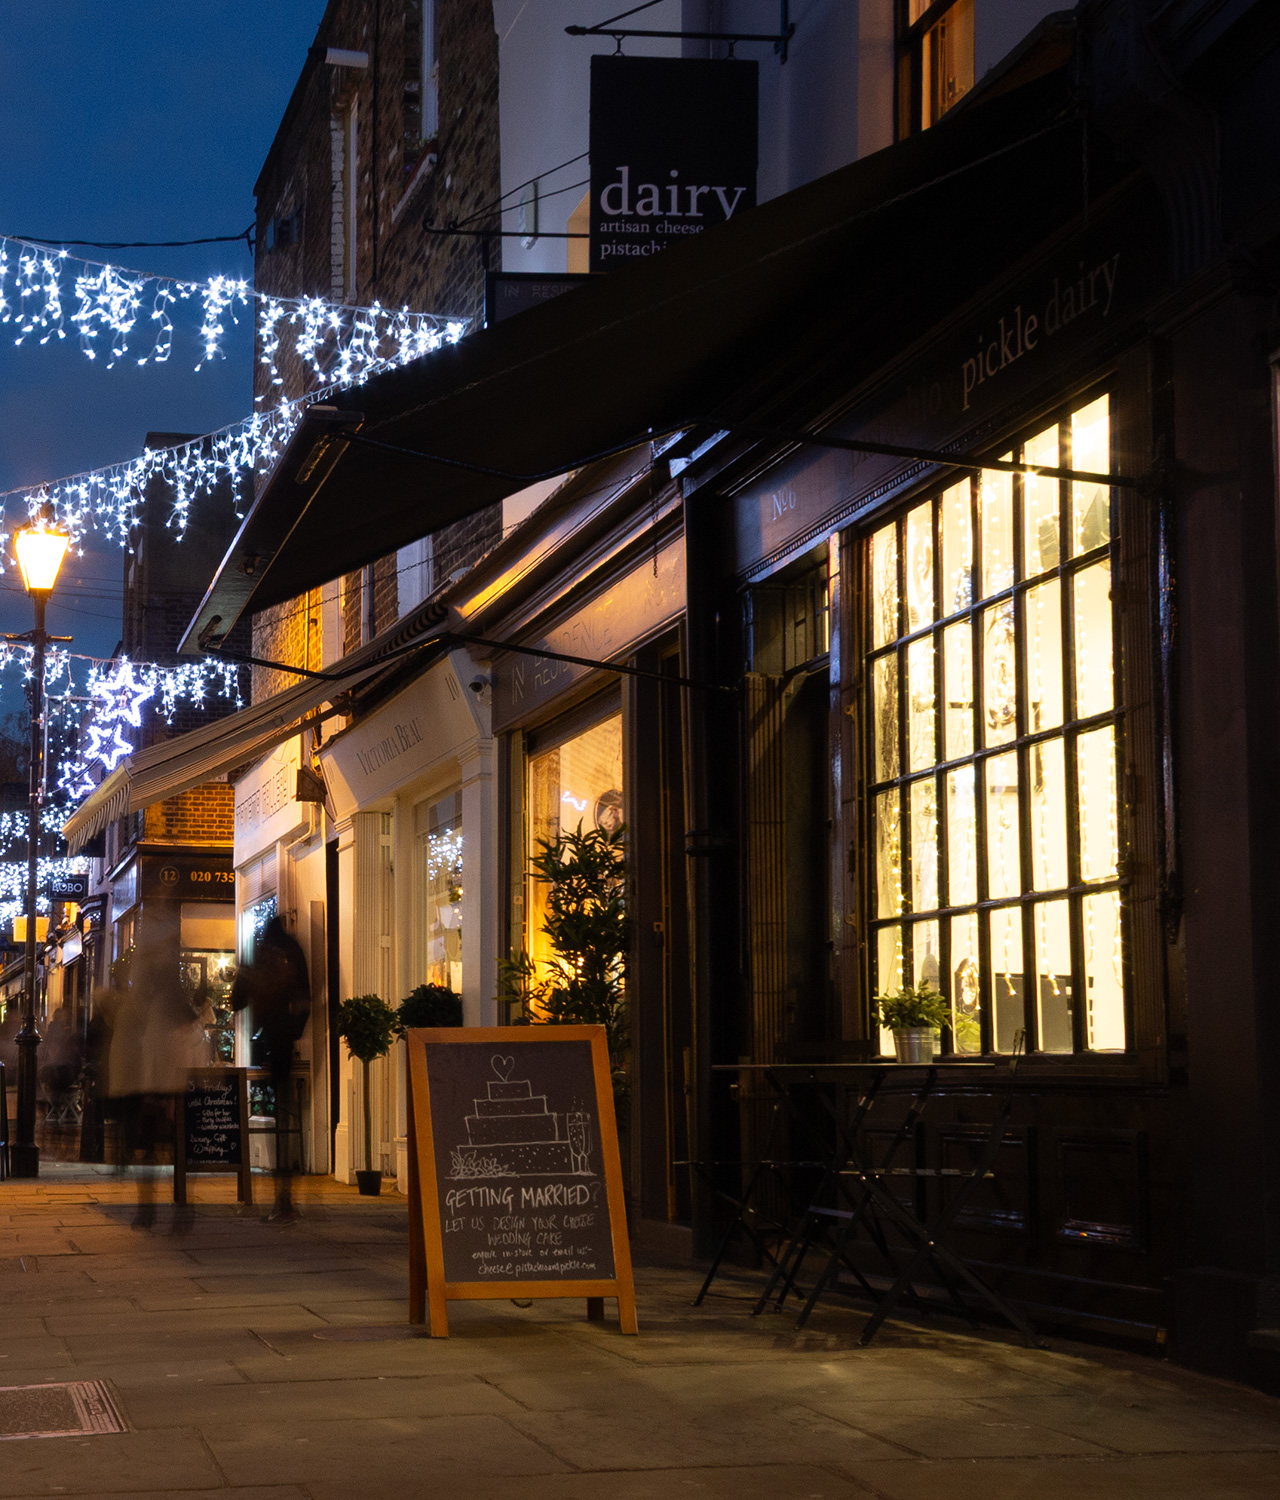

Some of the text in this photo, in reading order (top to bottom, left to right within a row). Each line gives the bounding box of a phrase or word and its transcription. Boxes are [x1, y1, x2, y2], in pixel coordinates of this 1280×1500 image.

[600, 166, 747, 221] dairy
[600, 221, 650, 233] artisan
[504, 285, 519, 298] IN
[962, 252, 1119, 411] pickle dairy
[512, 661, 524, 705] IN
[163, 870, 235, 883] 12 020 735
[52, 882, 83, 893] BOBO
[202, 1080, 232, 1099] Fridays
[445, 1181, 603, 1216] GETTING MARRIED?
[445, 1217, 466, 1233] LET
[471, 1216, 485, 1231] US
[493, 1215, 525, 1232] DESIGN
[532, 1214, 558, 1231] YOUR
[487, 1231, 563, 1248] WEDDING CAKE
[539, 1249, 549, 1258] or
[553, 1245, 574, 1257] email
